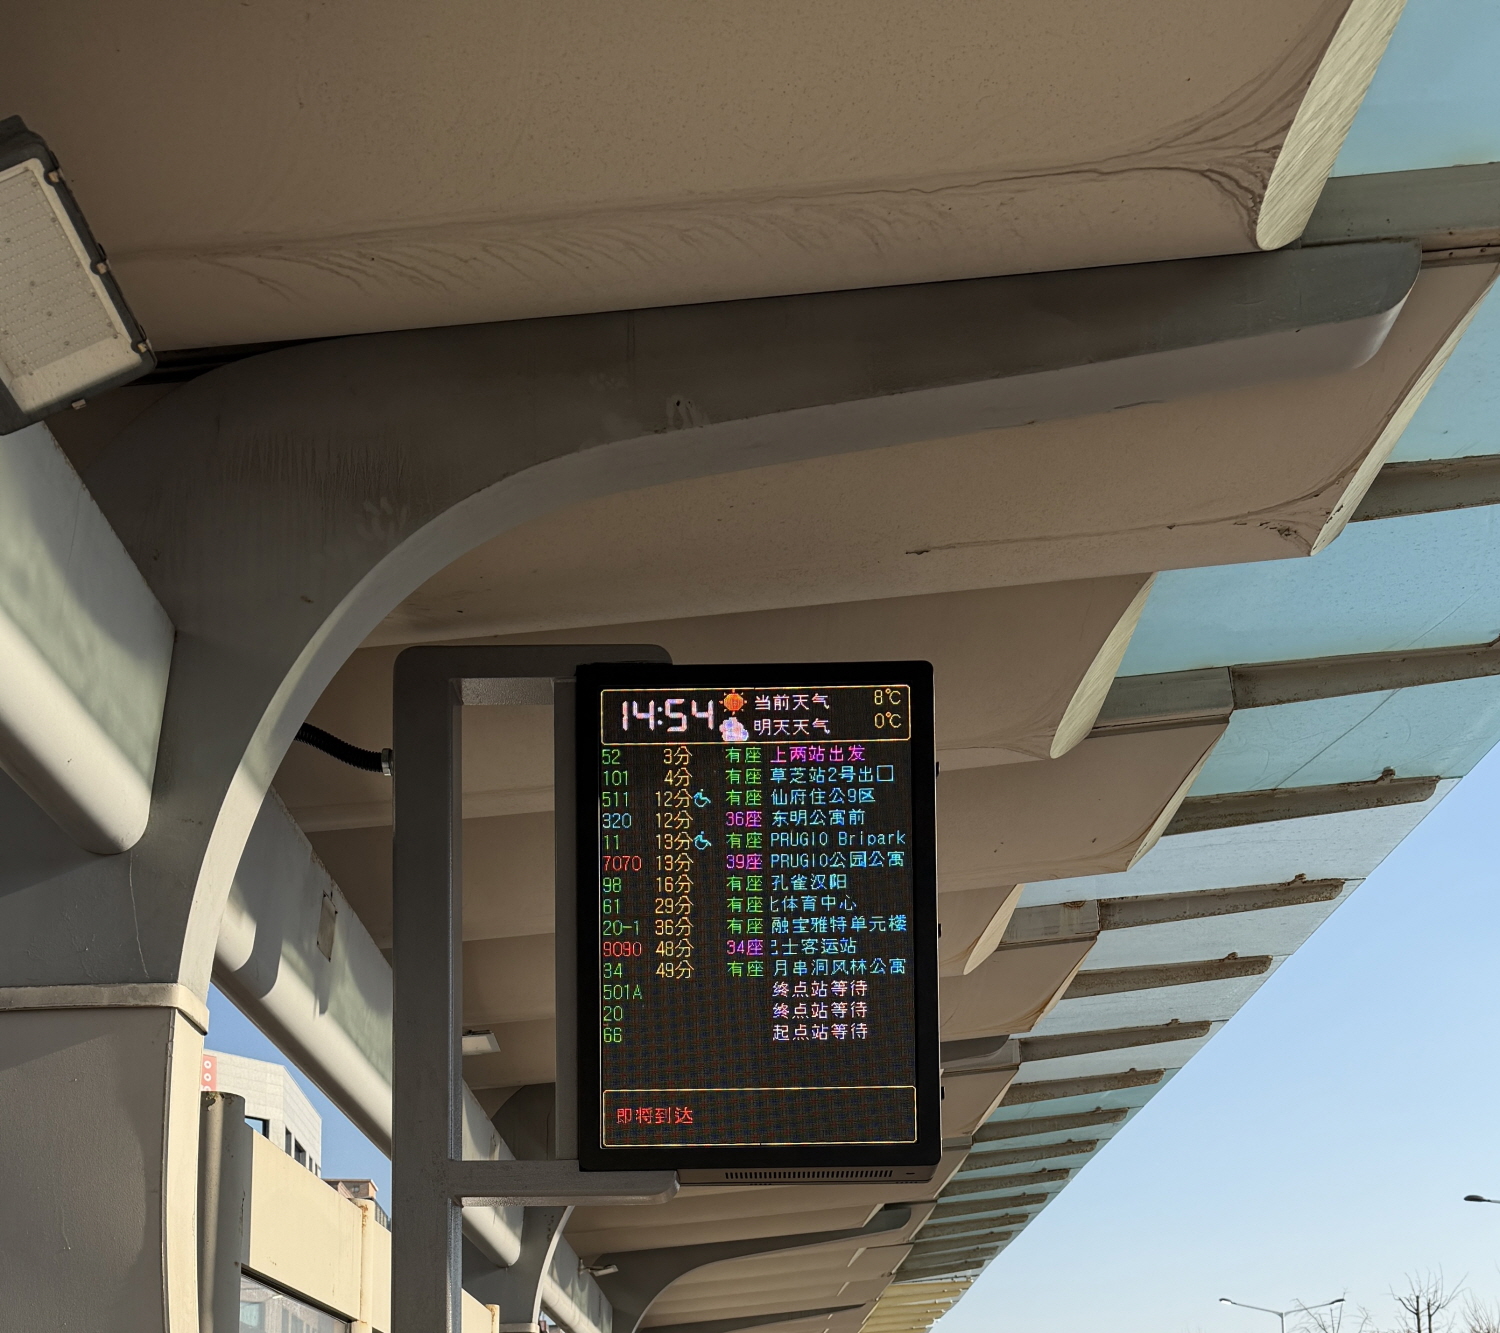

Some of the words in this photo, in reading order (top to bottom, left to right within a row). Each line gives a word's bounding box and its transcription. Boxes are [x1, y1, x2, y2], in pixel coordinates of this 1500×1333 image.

[754, 692, 830, 711] 当前天气
[622, 698, 714, 733] 14:54
[753, 717, 831, 736] 明天天气
[602, 748, 620, 765] 52
[663, 745, 693, 766] 3分
[725, 746, 762, 763] 有座
[769, 744, 866, 763] 上两站出发
[603, 770, 628, 786] 101
[663, 767, 693, 787] 4分
[725, 767, 762, 785] 有座
[602, 791, 628, 807] 511
[655, 788, 693, 808] 12分
[725, 788, 762, 806] 有座
[770, 787, 876, 806] 仙府住公9区
[602, 812, 632, 829] 320
[655, 809, 694, 830] 12分
[725, 810, 763, 828] 36座
[771, 808, 866, 828] 东明公寓前
[604, 834, 619, 850] 11
[655, 831, 694, 851] 13分
[725, 831, 763, 849] 有座
[770, 831, 828, 847] PRUGIO
[838, 829, 906, 846] Bripark
[603, 855, 642, 872] 7070
[656, 852, 694, 872] 13分
[726, 853, 763, 870] 39座
[770, 850, 905, 869] PRUGIO公园公寓
[602, 877, 622, 893] 98
[656, 873, 694, 894] 16分
[726, 875, 763, 892] 有座
[771, 873, 847, 891] 孔雀汉阳
[603, 898, 619, 914] 61
[654, 895, 694, 915] 29分
[726, 897, 764, 913] 有座
[602, 919, 639, 936] 20-1
[654, 917, 694, 938] 36分
[726, 918, 764, 935] 有座
[603, 941, 642, 958] 9090
[655, 938, 695, 958] 48分
[726, 939, 764, 956] 34座
[603, 962, 623, 979] 34
[655, 959, 695, 980] 49分
[726, 960, 764, 977] 有座
[773, 957, 907, 977] 月串洞风林公寓
[603, 984, 643, 1000] 501A
[771, 979, 868, 998] 终点站等待
[603, 1005, 623, 1022] 20
[772, 1001, 868, 1020] 终点站等待
[603, 1027, 622, 1043] 66
[772, 1022, 868, 1041] 起点站等待
[616, 1106, 694, 1124] 即将到达
